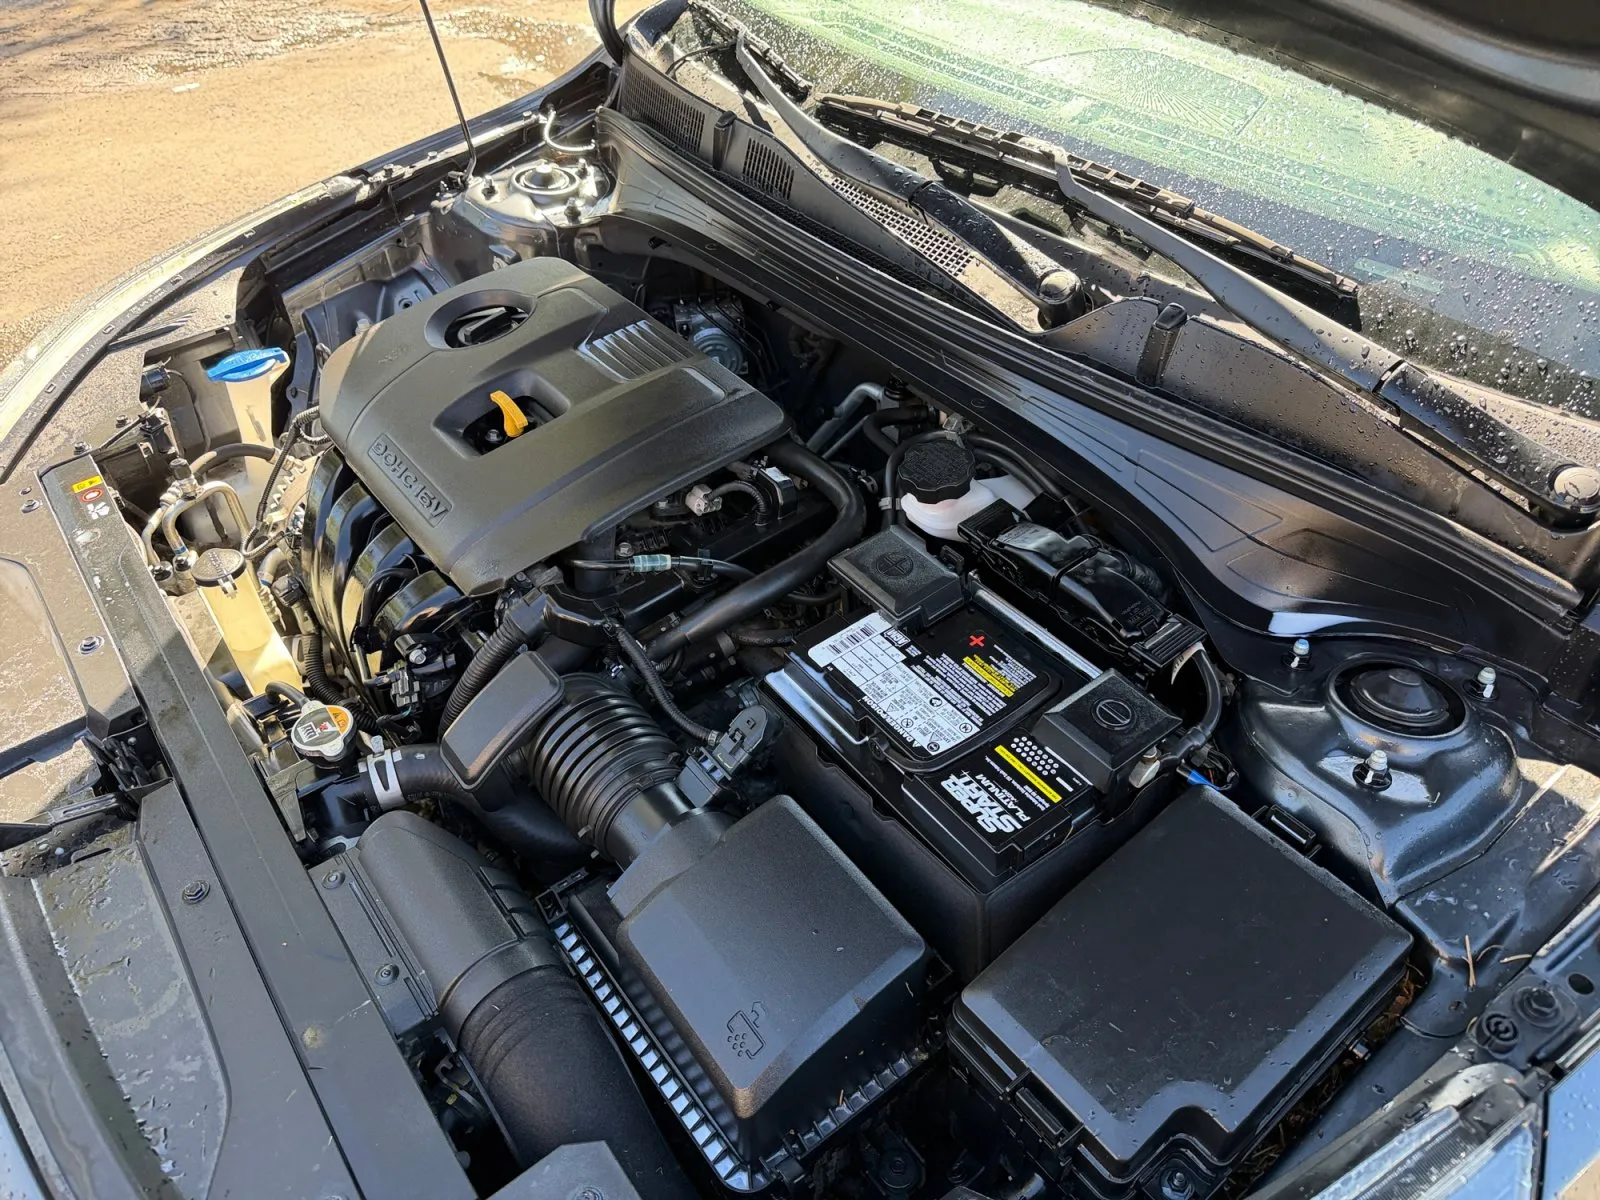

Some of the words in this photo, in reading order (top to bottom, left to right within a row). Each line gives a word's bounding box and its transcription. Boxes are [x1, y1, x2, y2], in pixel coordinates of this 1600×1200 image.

[372, 442, 418, 489] DOHC
[861, 695, 913, 742] DANGER/POISON
[940, 777, 996, 833] SUPER
[948, 774, 1023, 832] START
[974, 773, 1031, 822] PLATINUM
